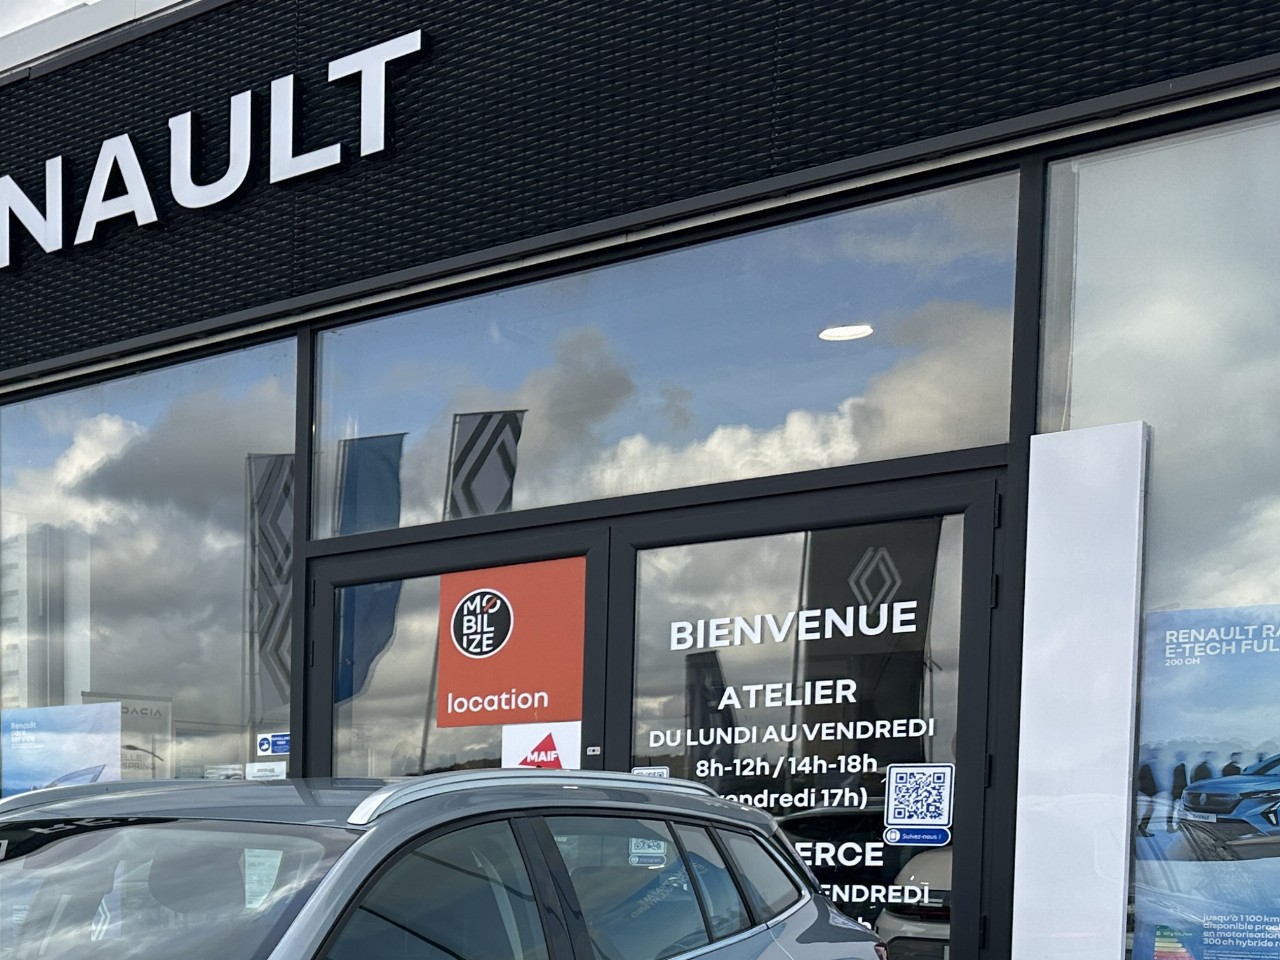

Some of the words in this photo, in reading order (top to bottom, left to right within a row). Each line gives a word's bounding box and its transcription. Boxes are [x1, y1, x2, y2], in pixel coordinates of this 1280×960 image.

[669, 600, 919, 651] BIENVENUE
[1165, 625, 1258, 643] RENAULT
[1165, 641, 1236, 658] E-TECH
[1164, 658, 1183, 667] 200
[1185, 657, 1200, 665] CH
[447, 688, 549, 713] location
[717, 678, 858, 710] ATELIER
[649, 729, 681, 748] DU
[686, 726, 757, 746] LUNDI
[761, 724, 797, 743] AU
[801, 717, 935, 742] VENDREDI
[526, 750, 559, 763] MAIF
[695, 756, 770, 777] 8h-12h
[772, 756, 785, 779] /
[788, 753, 878, 775] 14h-18h
[820, 786, 869, 810] 17h)
[1203, 922, 1254, 930] disponible
[1235, 939, 1273, 948] hybride
